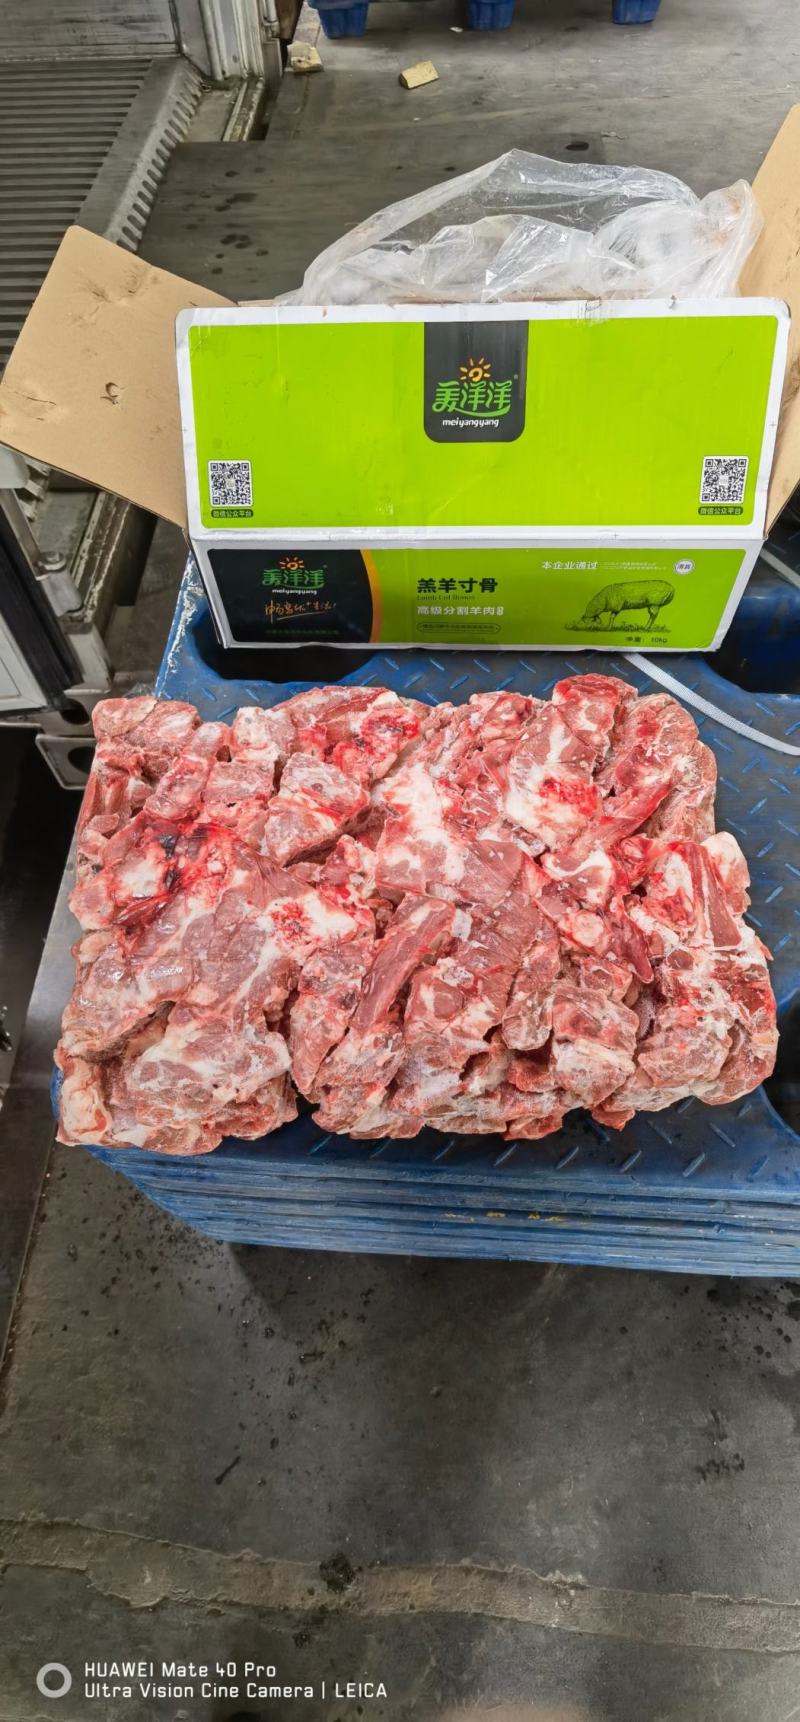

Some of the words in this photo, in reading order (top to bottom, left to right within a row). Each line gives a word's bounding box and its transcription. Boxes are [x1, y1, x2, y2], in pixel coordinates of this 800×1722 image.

[442, 417, 500, 428] meiyangyang
[542, 561, 598, 570] 本企业通过
[417, 577, 498, 594] 羔羊寸骨
